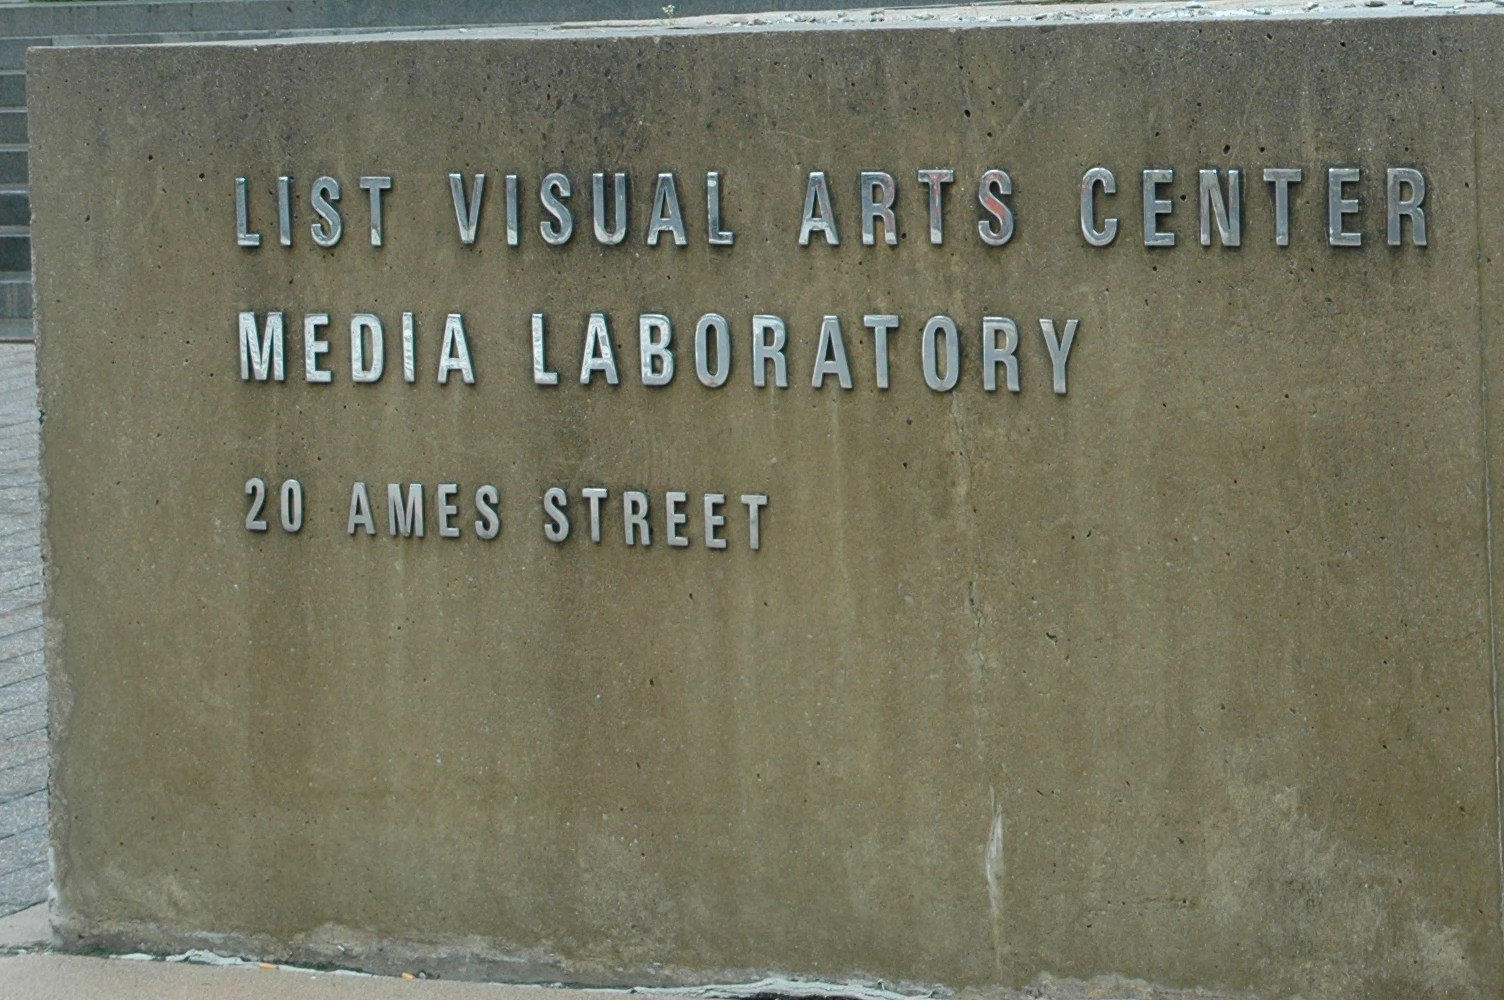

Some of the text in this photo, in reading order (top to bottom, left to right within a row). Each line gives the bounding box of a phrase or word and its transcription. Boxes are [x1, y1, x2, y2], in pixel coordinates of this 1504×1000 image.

[234, 167, 1429, 249] LIST VISUAL ARTS CENTER
[237, 310, 1080, 395] MEDIA LABORATORY
[244, 477, 769, 551] 20 AMES STREET
